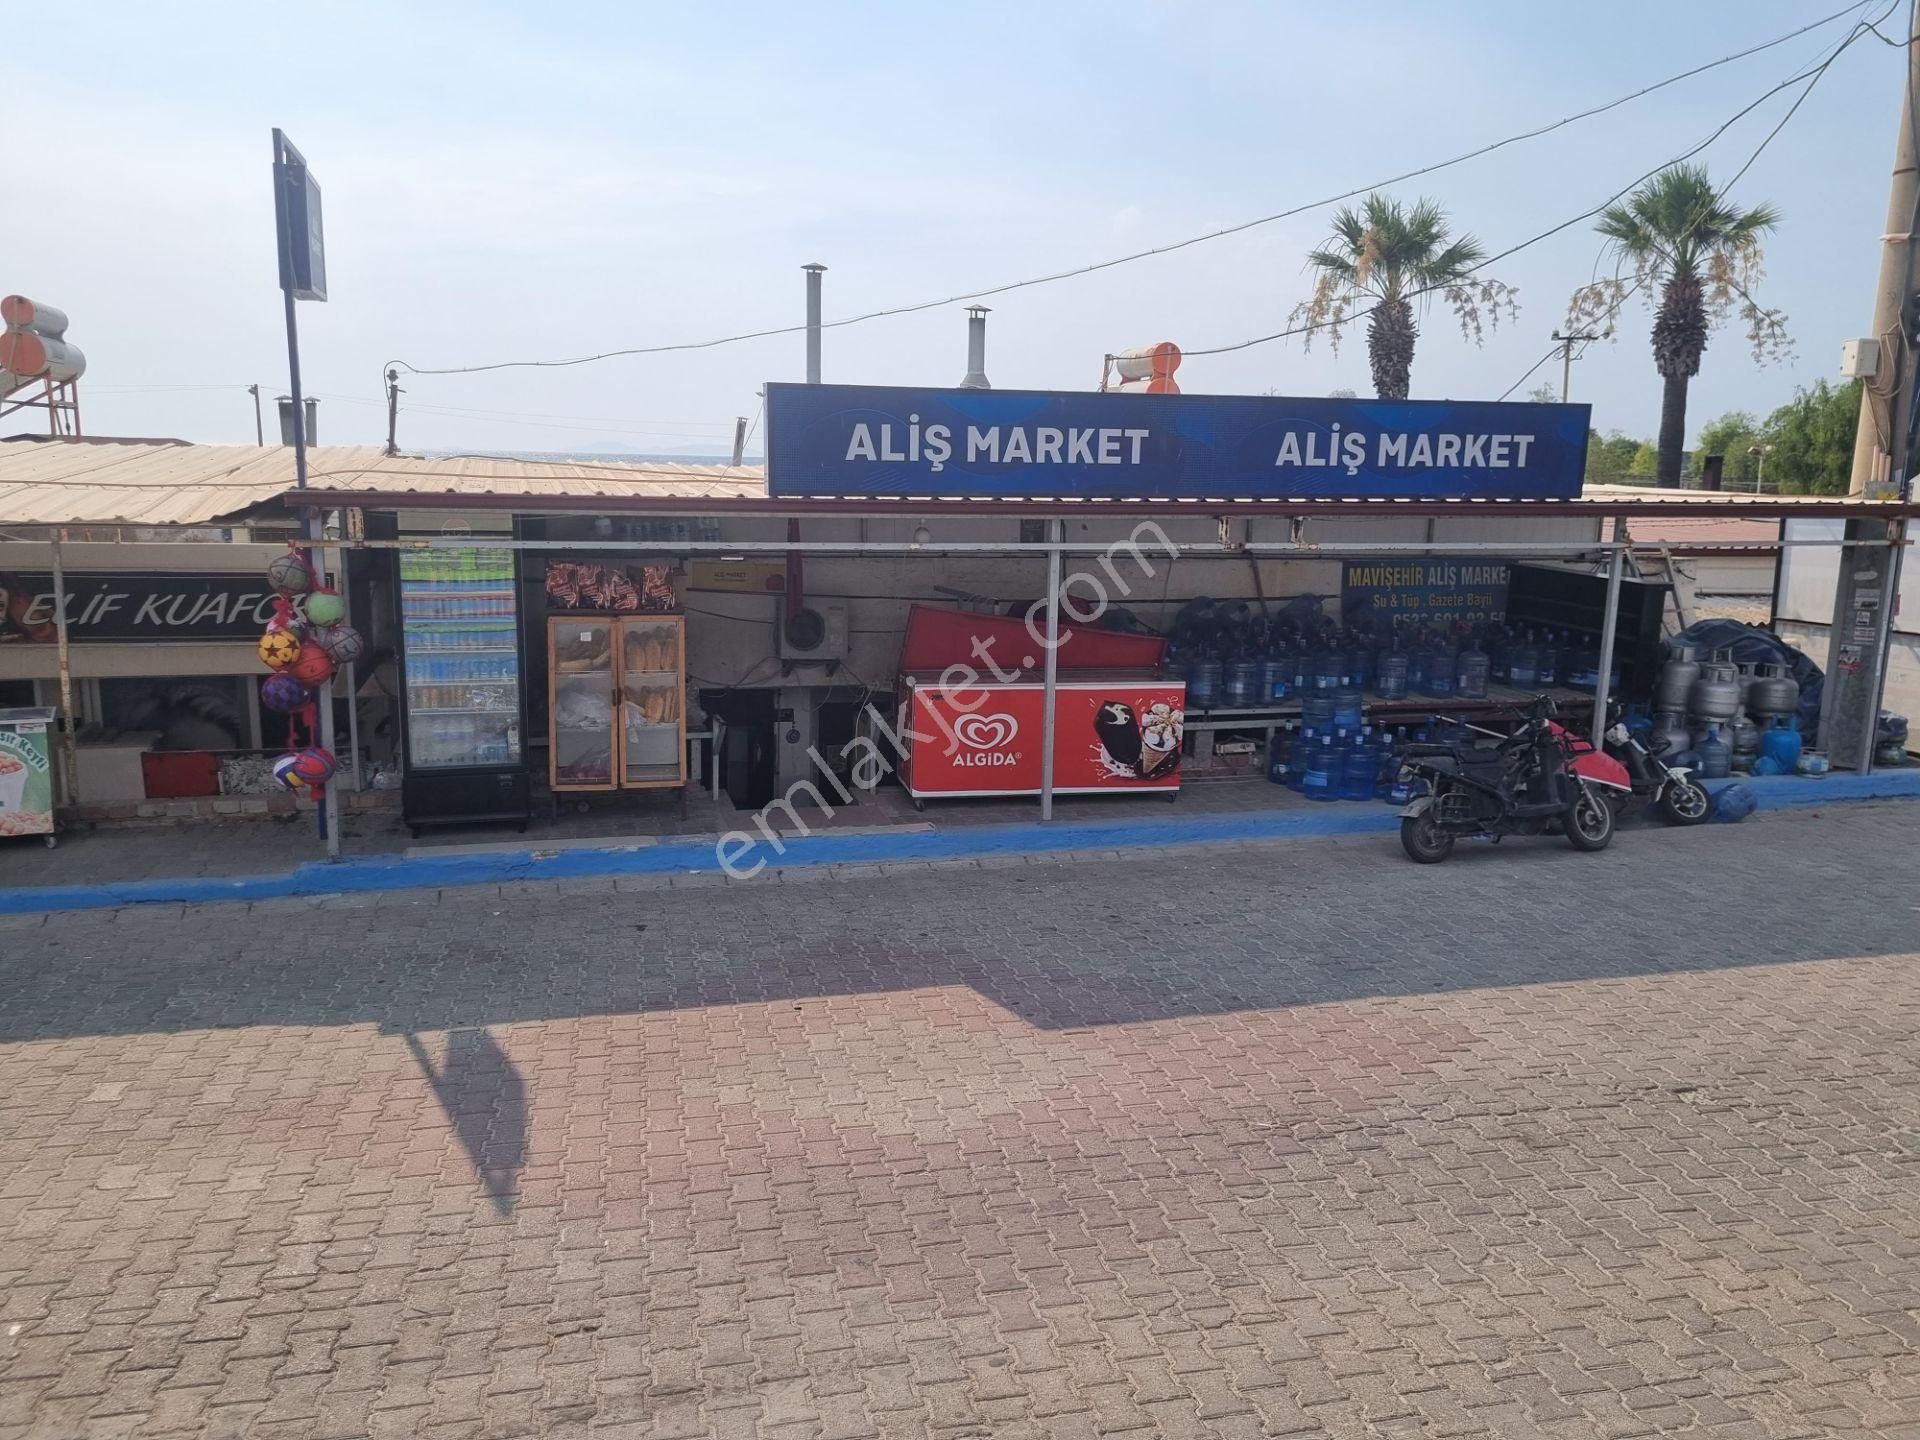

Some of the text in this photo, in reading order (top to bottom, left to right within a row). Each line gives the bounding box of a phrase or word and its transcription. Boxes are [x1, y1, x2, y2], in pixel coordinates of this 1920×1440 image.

[845, 414, 1149, 472] ALİŞ MARKET
[1275, 422, 1535, 475] ALİŞ MARKET
[1349, 562, 1423, 591] MAVİŞEHİR
[1427, 562, 1456, 590] ALİŞ
[22, 584, 129, 626] ELİF
[1373, 594, 1386, 608] Su
[1390, 594, 1398, 607] &
[1401, 593, 1419, 609] Tüp
[1428, 592, 1464, 607] Gazete
[18, 739, 48, 769] Keyfi
